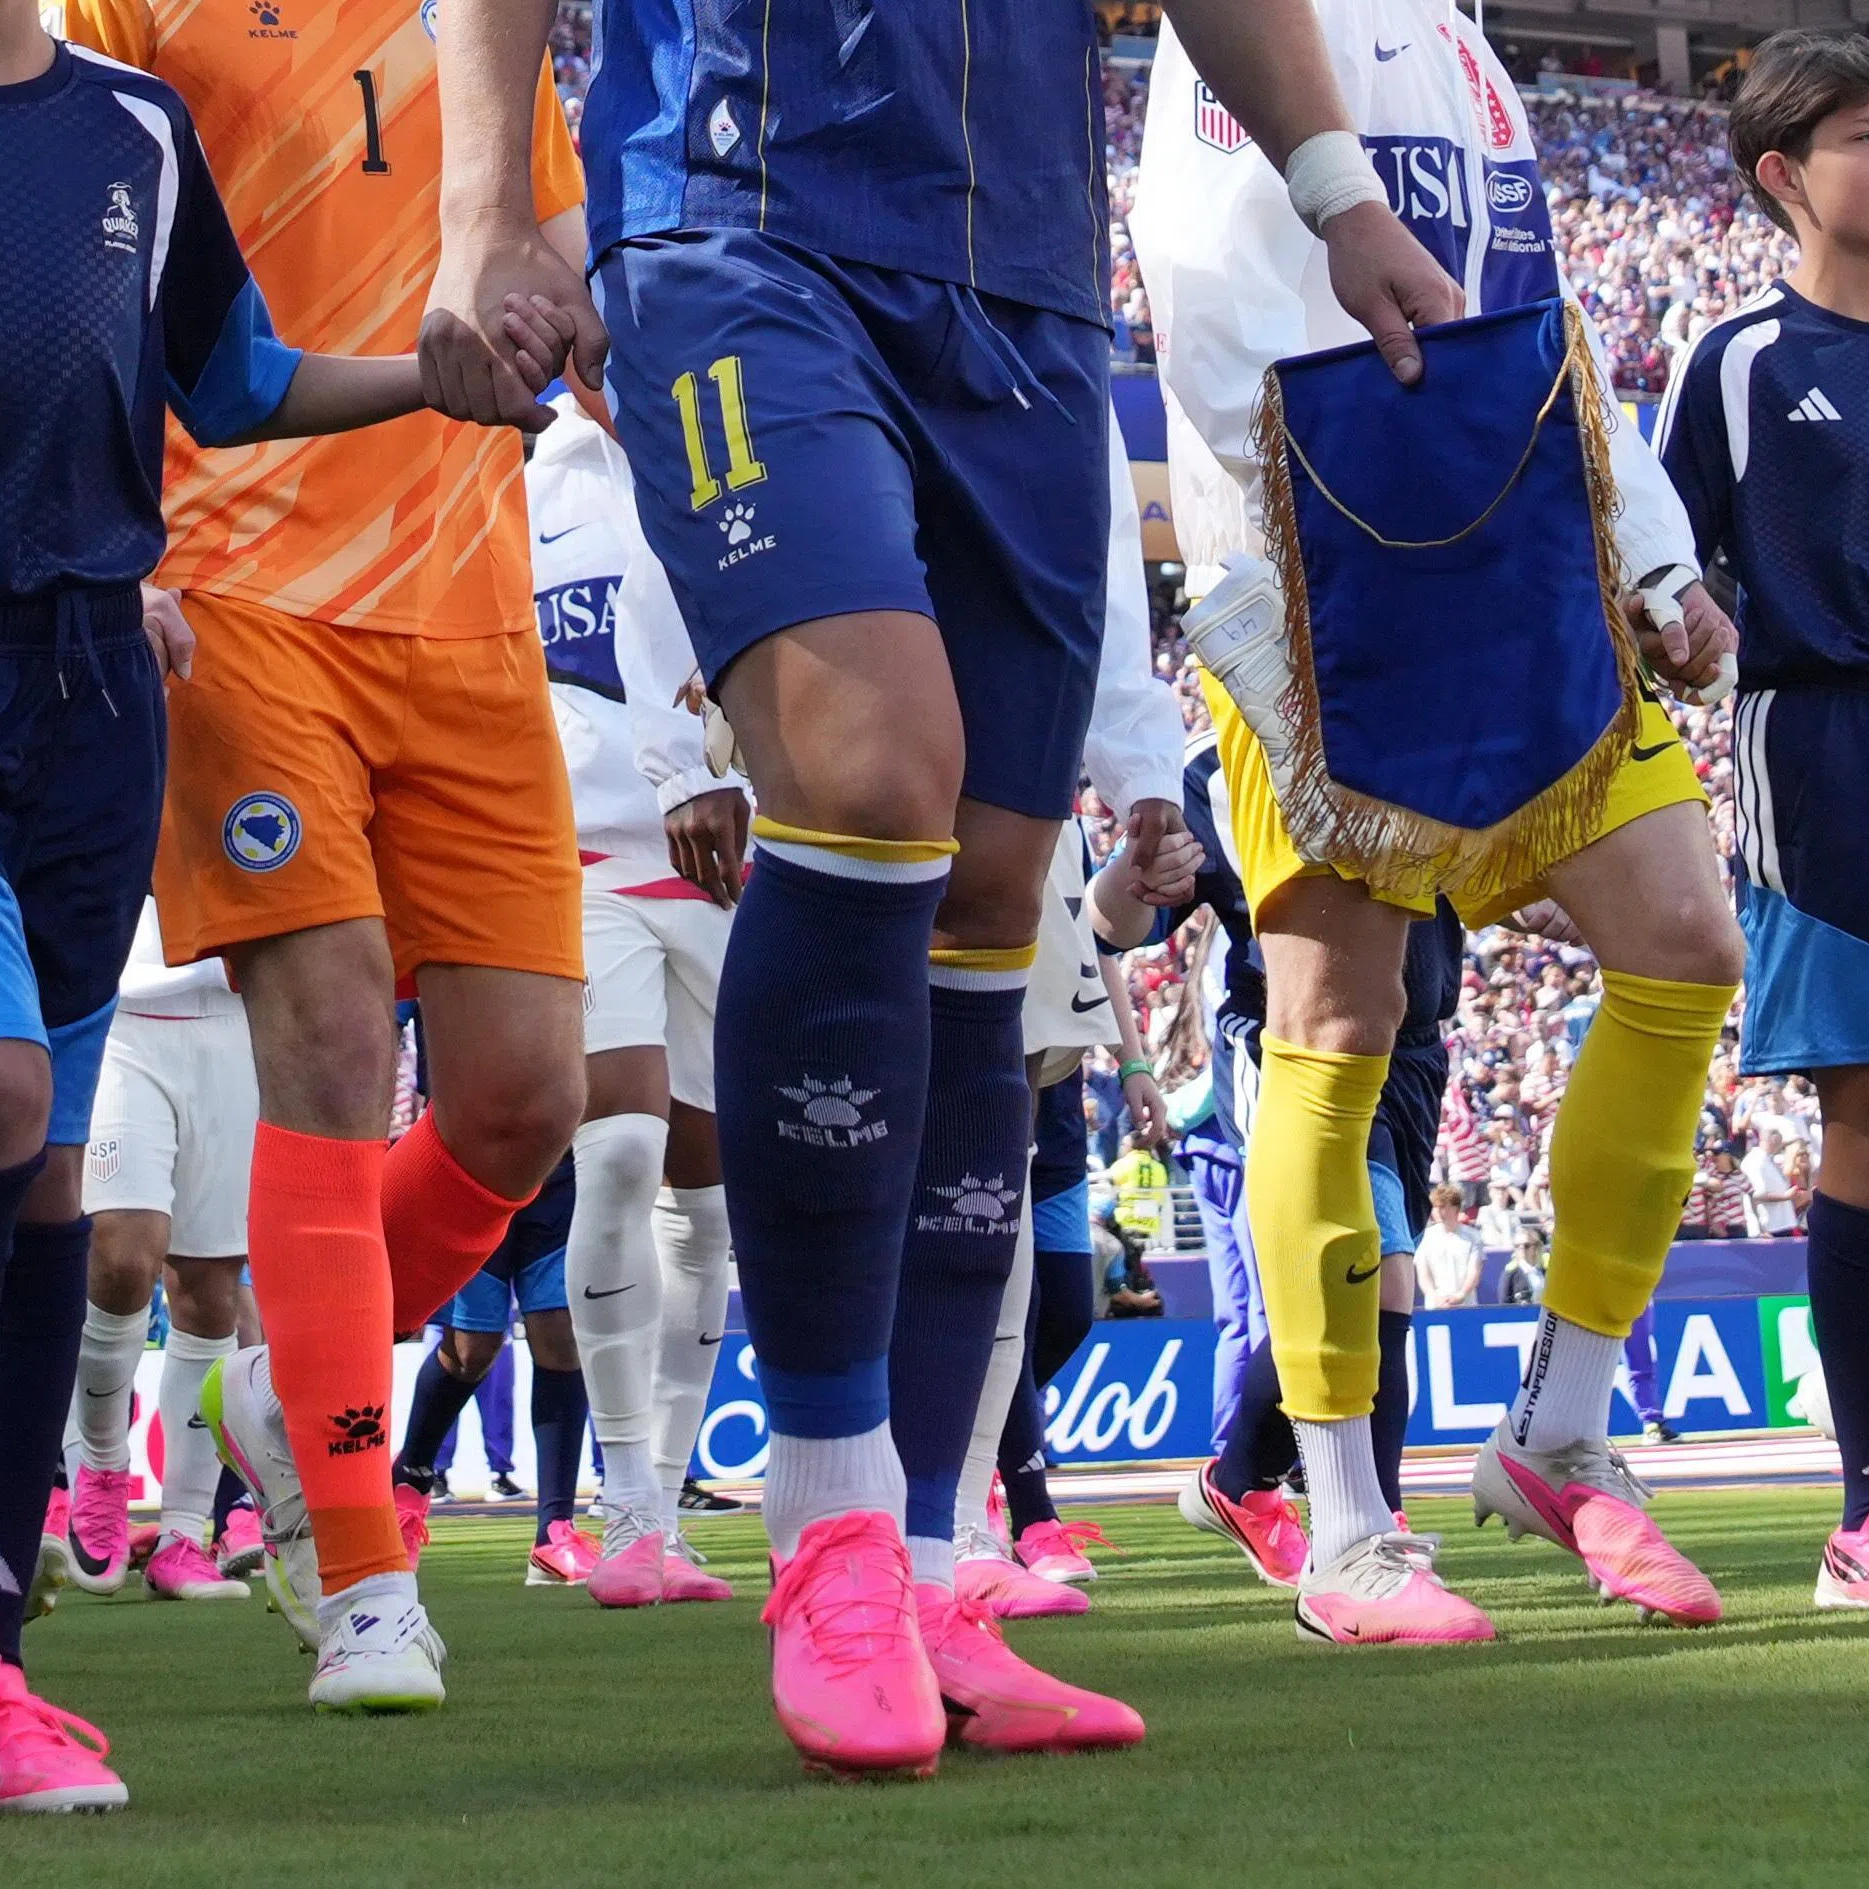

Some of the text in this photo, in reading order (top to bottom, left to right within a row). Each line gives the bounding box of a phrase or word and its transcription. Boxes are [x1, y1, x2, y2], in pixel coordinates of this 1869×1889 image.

[248, 28, 299, 39] KELME
[353, 69, 392, 176] 1
[671, 355, 767, 512] 11
[717, 534, 777, 572] KELME
[777, 1119, 890, 1148] KELME
[915, 1213, 1020, 1236] KELME
[328, 1430, 386, 1457] KELME
